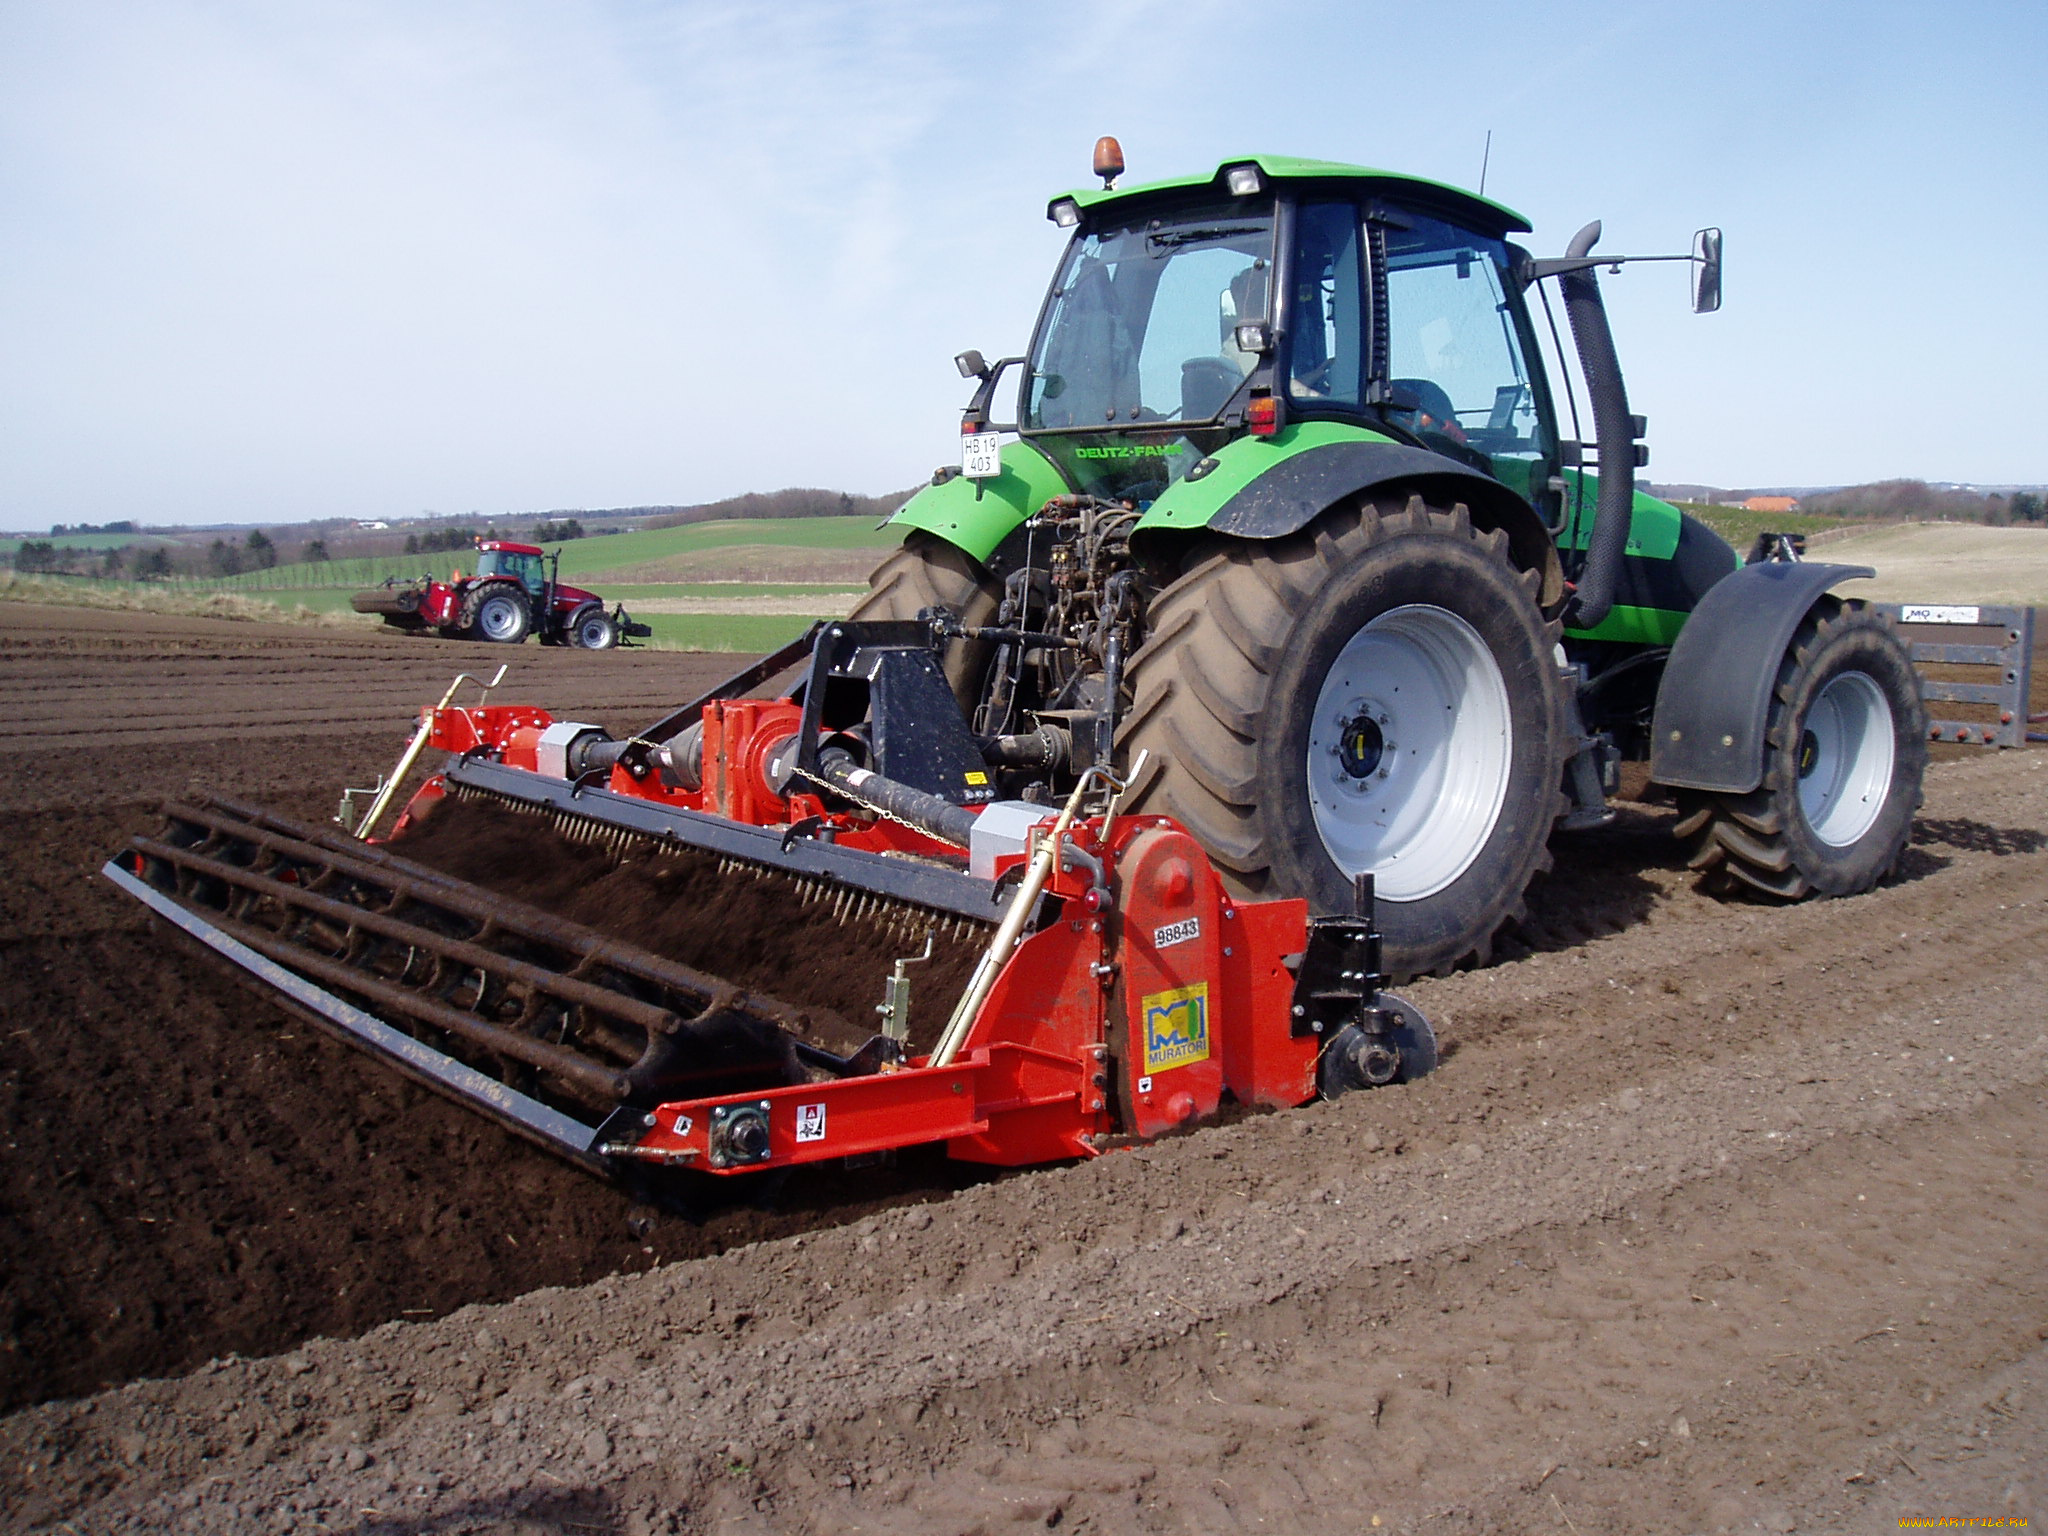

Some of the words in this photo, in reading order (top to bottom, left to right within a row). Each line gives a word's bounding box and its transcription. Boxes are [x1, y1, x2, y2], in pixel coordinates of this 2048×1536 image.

[965, 438, 980, 454] HB
[984, 437, 996, 452] 19
[970, 456, 991, 472] 403
[1156, 920, 1197, 946] 98843
[1148, 1039, 1207, 1065] MURATORI
